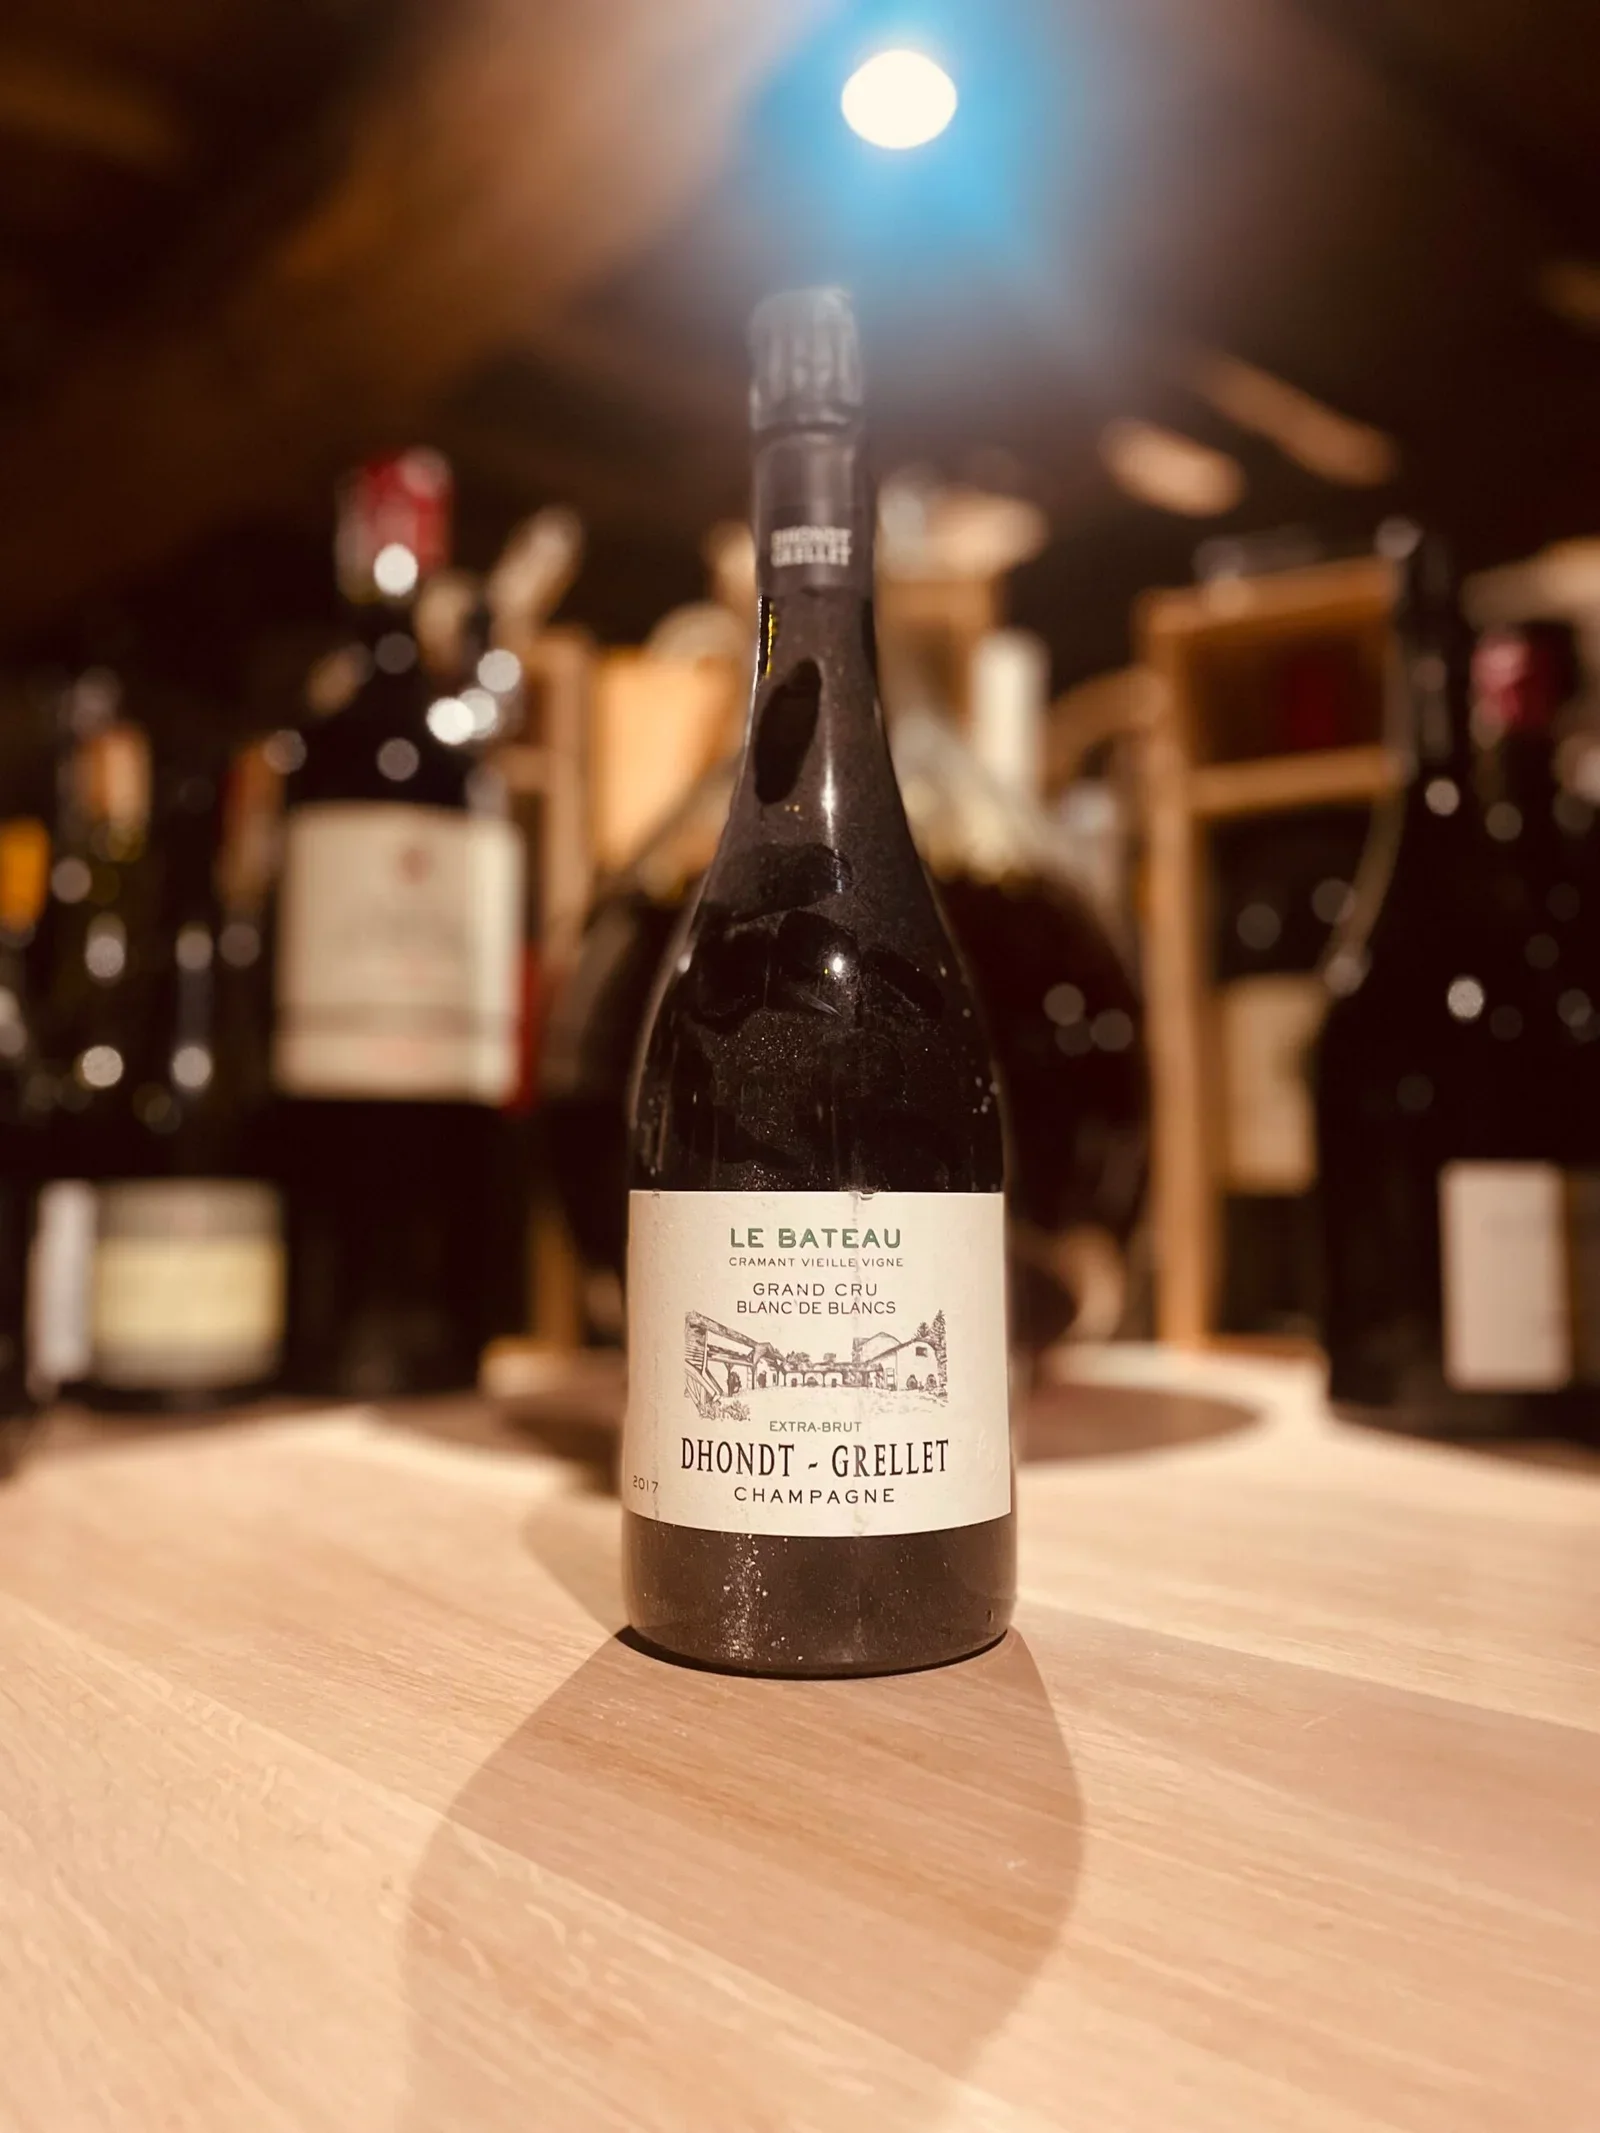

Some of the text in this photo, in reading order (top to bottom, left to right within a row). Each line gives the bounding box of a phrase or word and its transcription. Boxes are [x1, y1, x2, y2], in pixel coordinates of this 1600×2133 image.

[730, 1228, 901, 1249] LE BATEAU
[729, 1257, 903, 1268] CRAMANT VIEILLE VIGNE
[753, 1283, 878, 1297] GRAND CRU
[737, 1301, 896, 1315] BLANC DE BLANCS
[769, 1421, 862, 1433] EXTRA-BRUT
[681, 1438, 795, 1477] DHONDT
[832, 1439, 949, 1478] GRELLET
[632, 1475, 659, 1494] 2017
[734, 1487, 895, 1504] CHAMPAGNE
